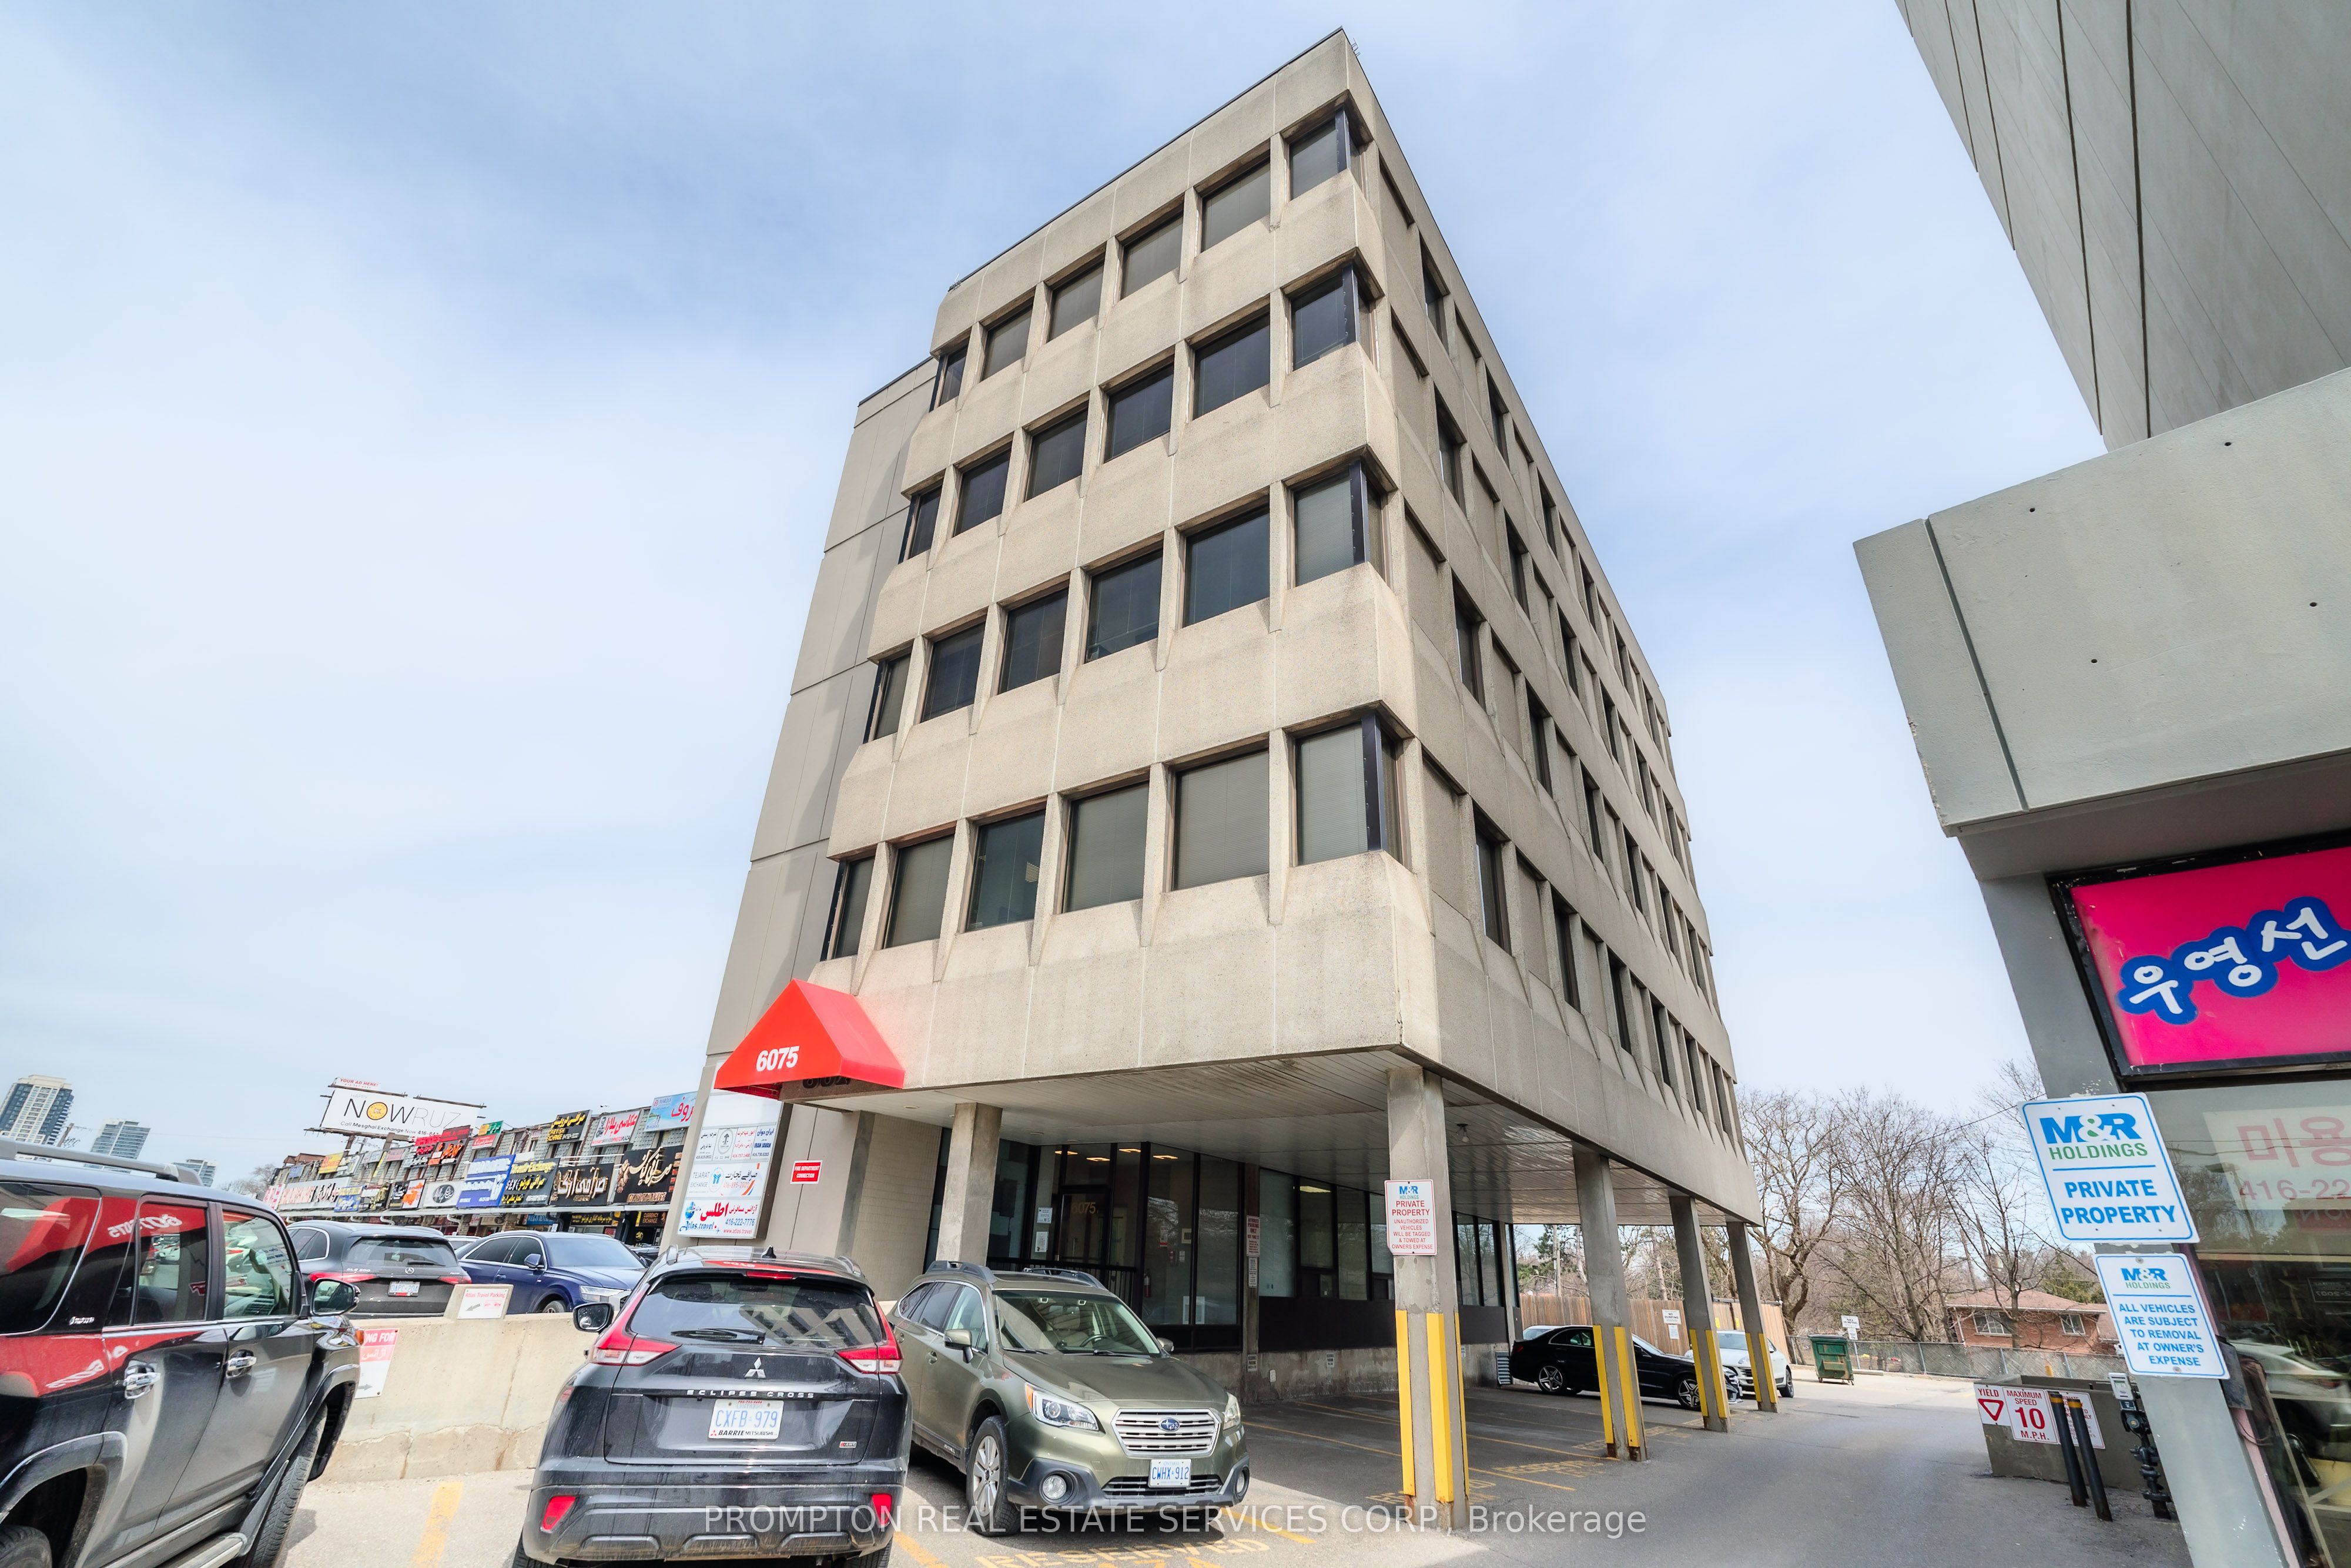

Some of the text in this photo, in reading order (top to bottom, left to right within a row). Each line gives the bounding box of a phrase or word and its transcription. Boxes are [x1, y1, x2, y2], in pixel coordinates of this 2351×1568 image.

[2129, 907, 2348, 1014] 우영선
[756, 1046, 800, 1072] 6075
[2039, 1112, 2142, 1144] M&R
[2049, 1143, 2148, 1160] HOLDINGS
[1399, 1185, 1418, 1194] M&R
[2064, 1179, 2158, 1198] PRIVATE
[700, 1201, 729, 1221] اطلس
[2061, 1205, 2176, 1224] PROPERTY
[2121, 1268, 2168, 1281] M&R
[2119, 1304, 2196, 1314] ALL VEHICLES
[2124, 1316, 2198, 1326] ARE SUBJECT
[2130, 1329, 2202, 1339] TO REMOVAL
[2137, 1342, 2204, 1353] AT OWNER'S
[2149, 1355, 2201, 1366] EXPENSE
[1978, 1388, 1999, 1397] YIELD
[2007, 1390, 2042, 1399] MAXIMUM
[2015, 1398, 2037, 1406] SPEED
[2015, 1407, 2045, 1429] 10
[2021, 1430, 2049, 1440] M.P.H.
[976, 1538, 1270, 1568] RESERVED
